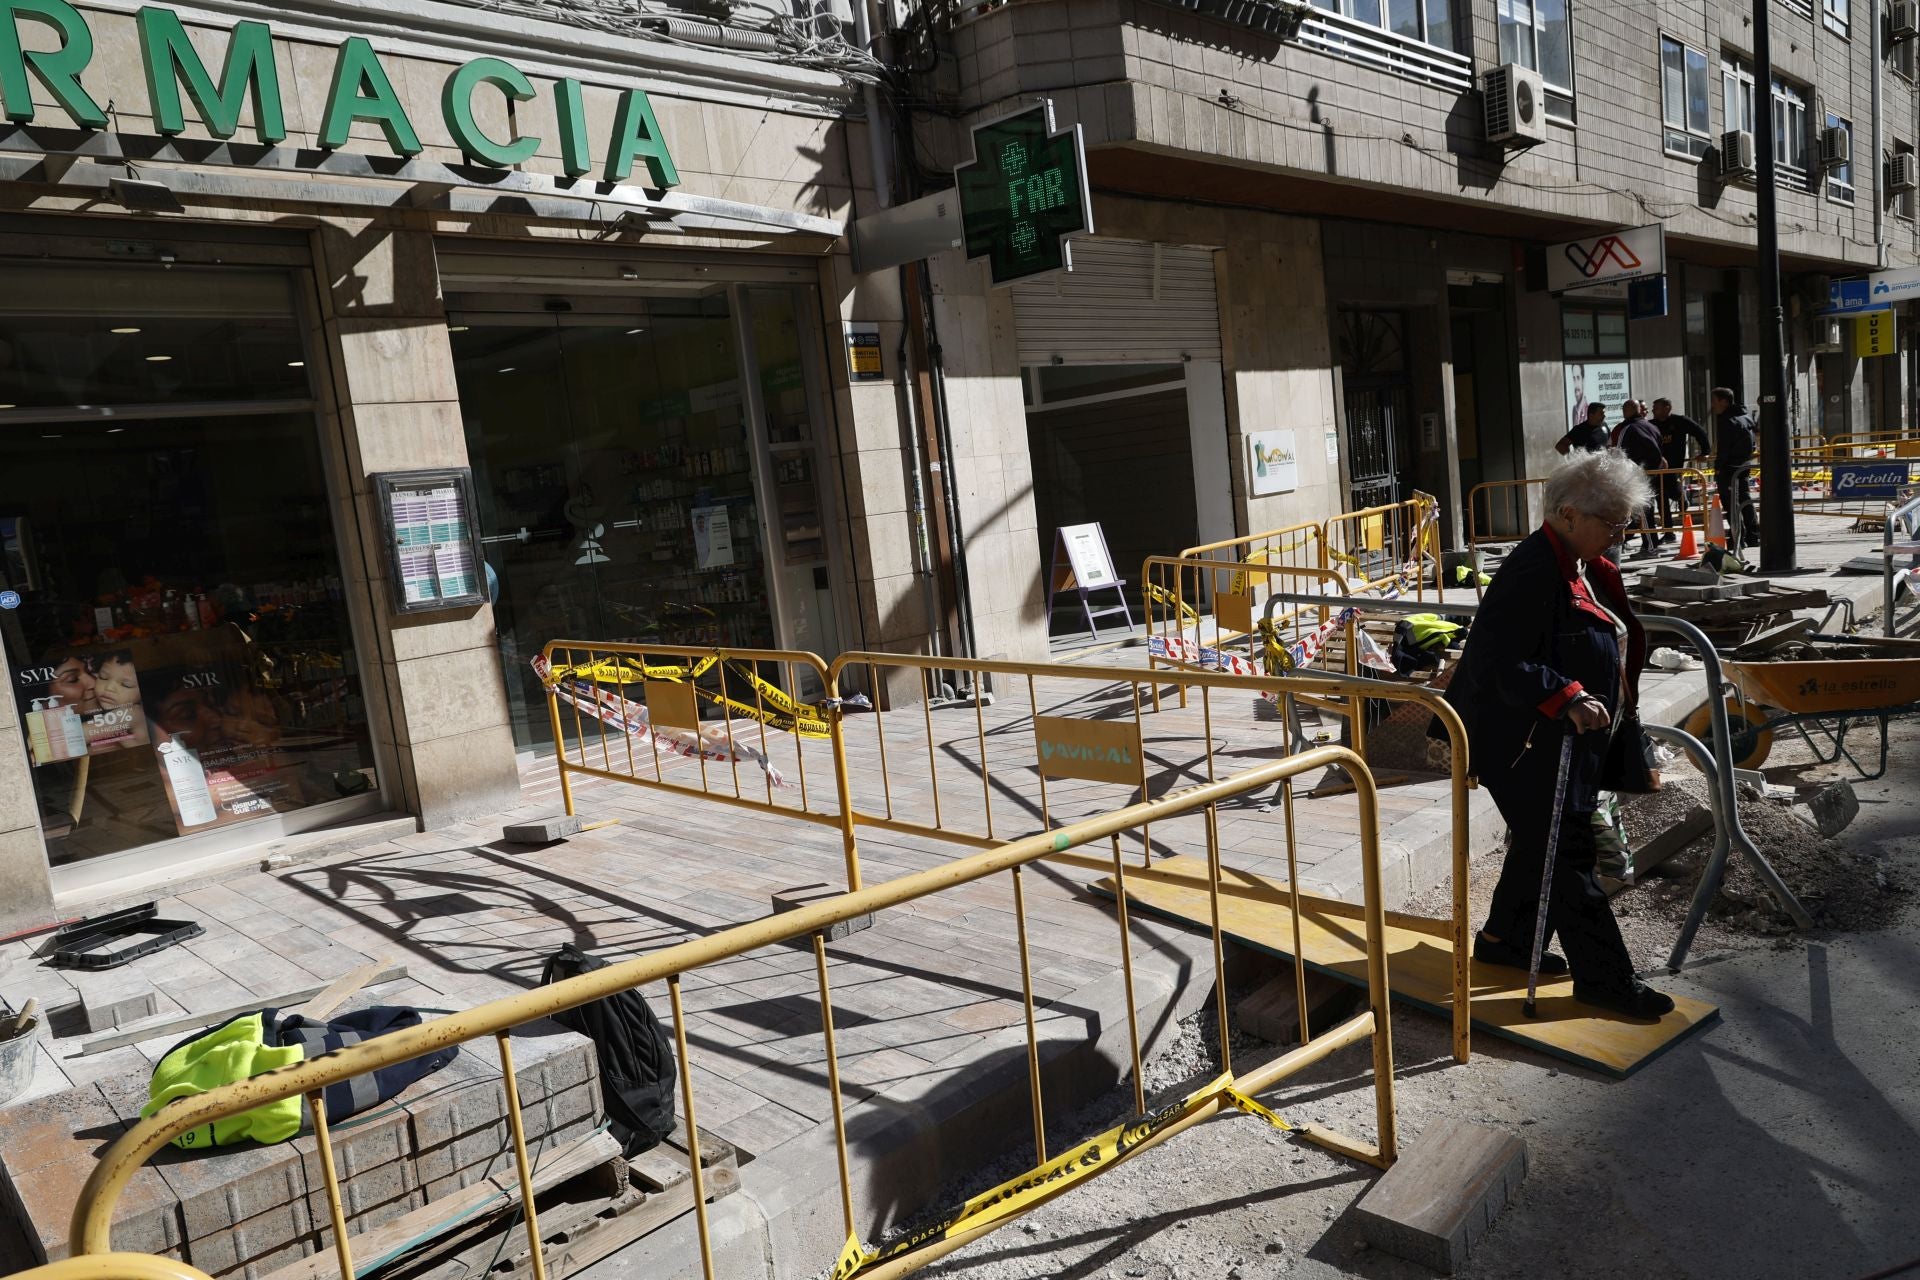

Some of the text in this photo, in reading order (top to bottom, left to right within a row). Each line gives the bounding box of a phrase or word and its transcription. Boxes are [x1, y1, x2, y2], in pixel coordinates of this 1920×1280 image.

[1009, 168, 1064, 217] FAR
[1845, 297, 1863, 307] ama
[1837, 471, 1902, 490] Bertolín
[20, 666, 59, 684] SVR
[182, 672, 220, 688] SVR
[87, 708, 132, 728] -50%
[172, 755, 192, 766] SVR
[178, 1131, 195, 1147] 19
